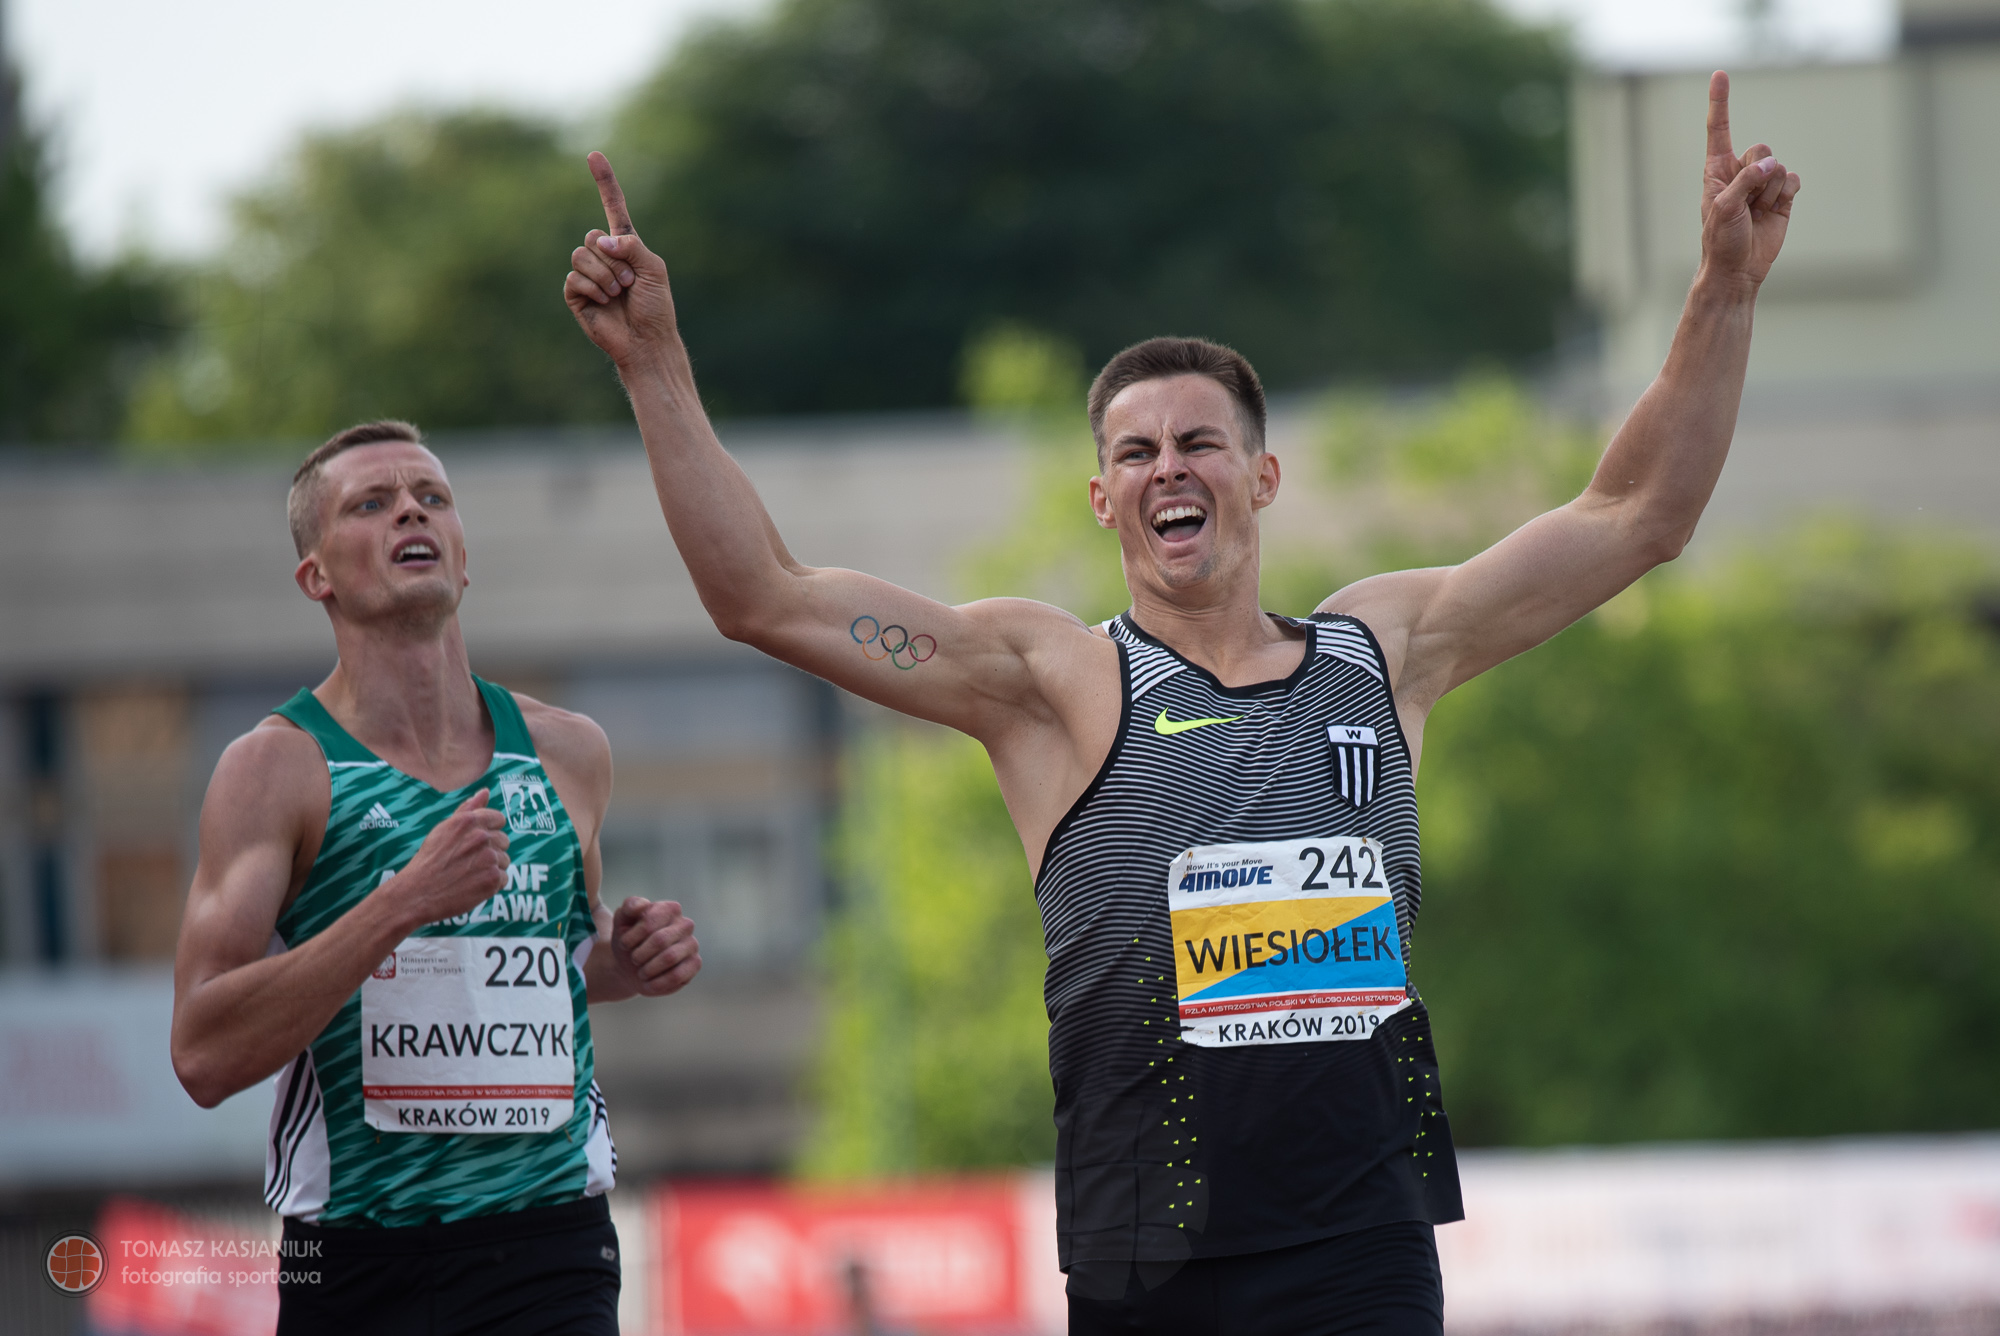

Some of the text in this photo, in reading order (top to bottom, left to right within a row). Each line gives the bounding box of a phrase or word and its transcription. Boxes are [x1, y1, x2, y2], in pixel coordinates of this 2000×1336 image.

[1345, 729, 1361, 740] W
[359, 818, 400, 830] adidas
[1221, 860, 1239, 868] your
[1241, 858, 1263, 866] Move
[1299, 845, 1383, 892] 242
[503, 864, 549, 892] WF
[1179, 865, 1274, 893] 4MOVE
[1185, 926, 1396, 974] WIESIOŁEK
[485, 946, 560, 988] 220
[1184, 1007, 1208, 1015] PZLA
[1208, 1000, 1268, 1013] MISTRZOSTWA
[1269, 998, 1298, 1007] POLSKI
[1308, 995, 1360, 1004] WIELOBOJACH
[371, 1023, 568, 1057] KRAWCZYK
[1219, 1012, 1380, 1043] KRAKÓW 2019
[398, 1102, 550, 1126] KRAKÓW 2019
